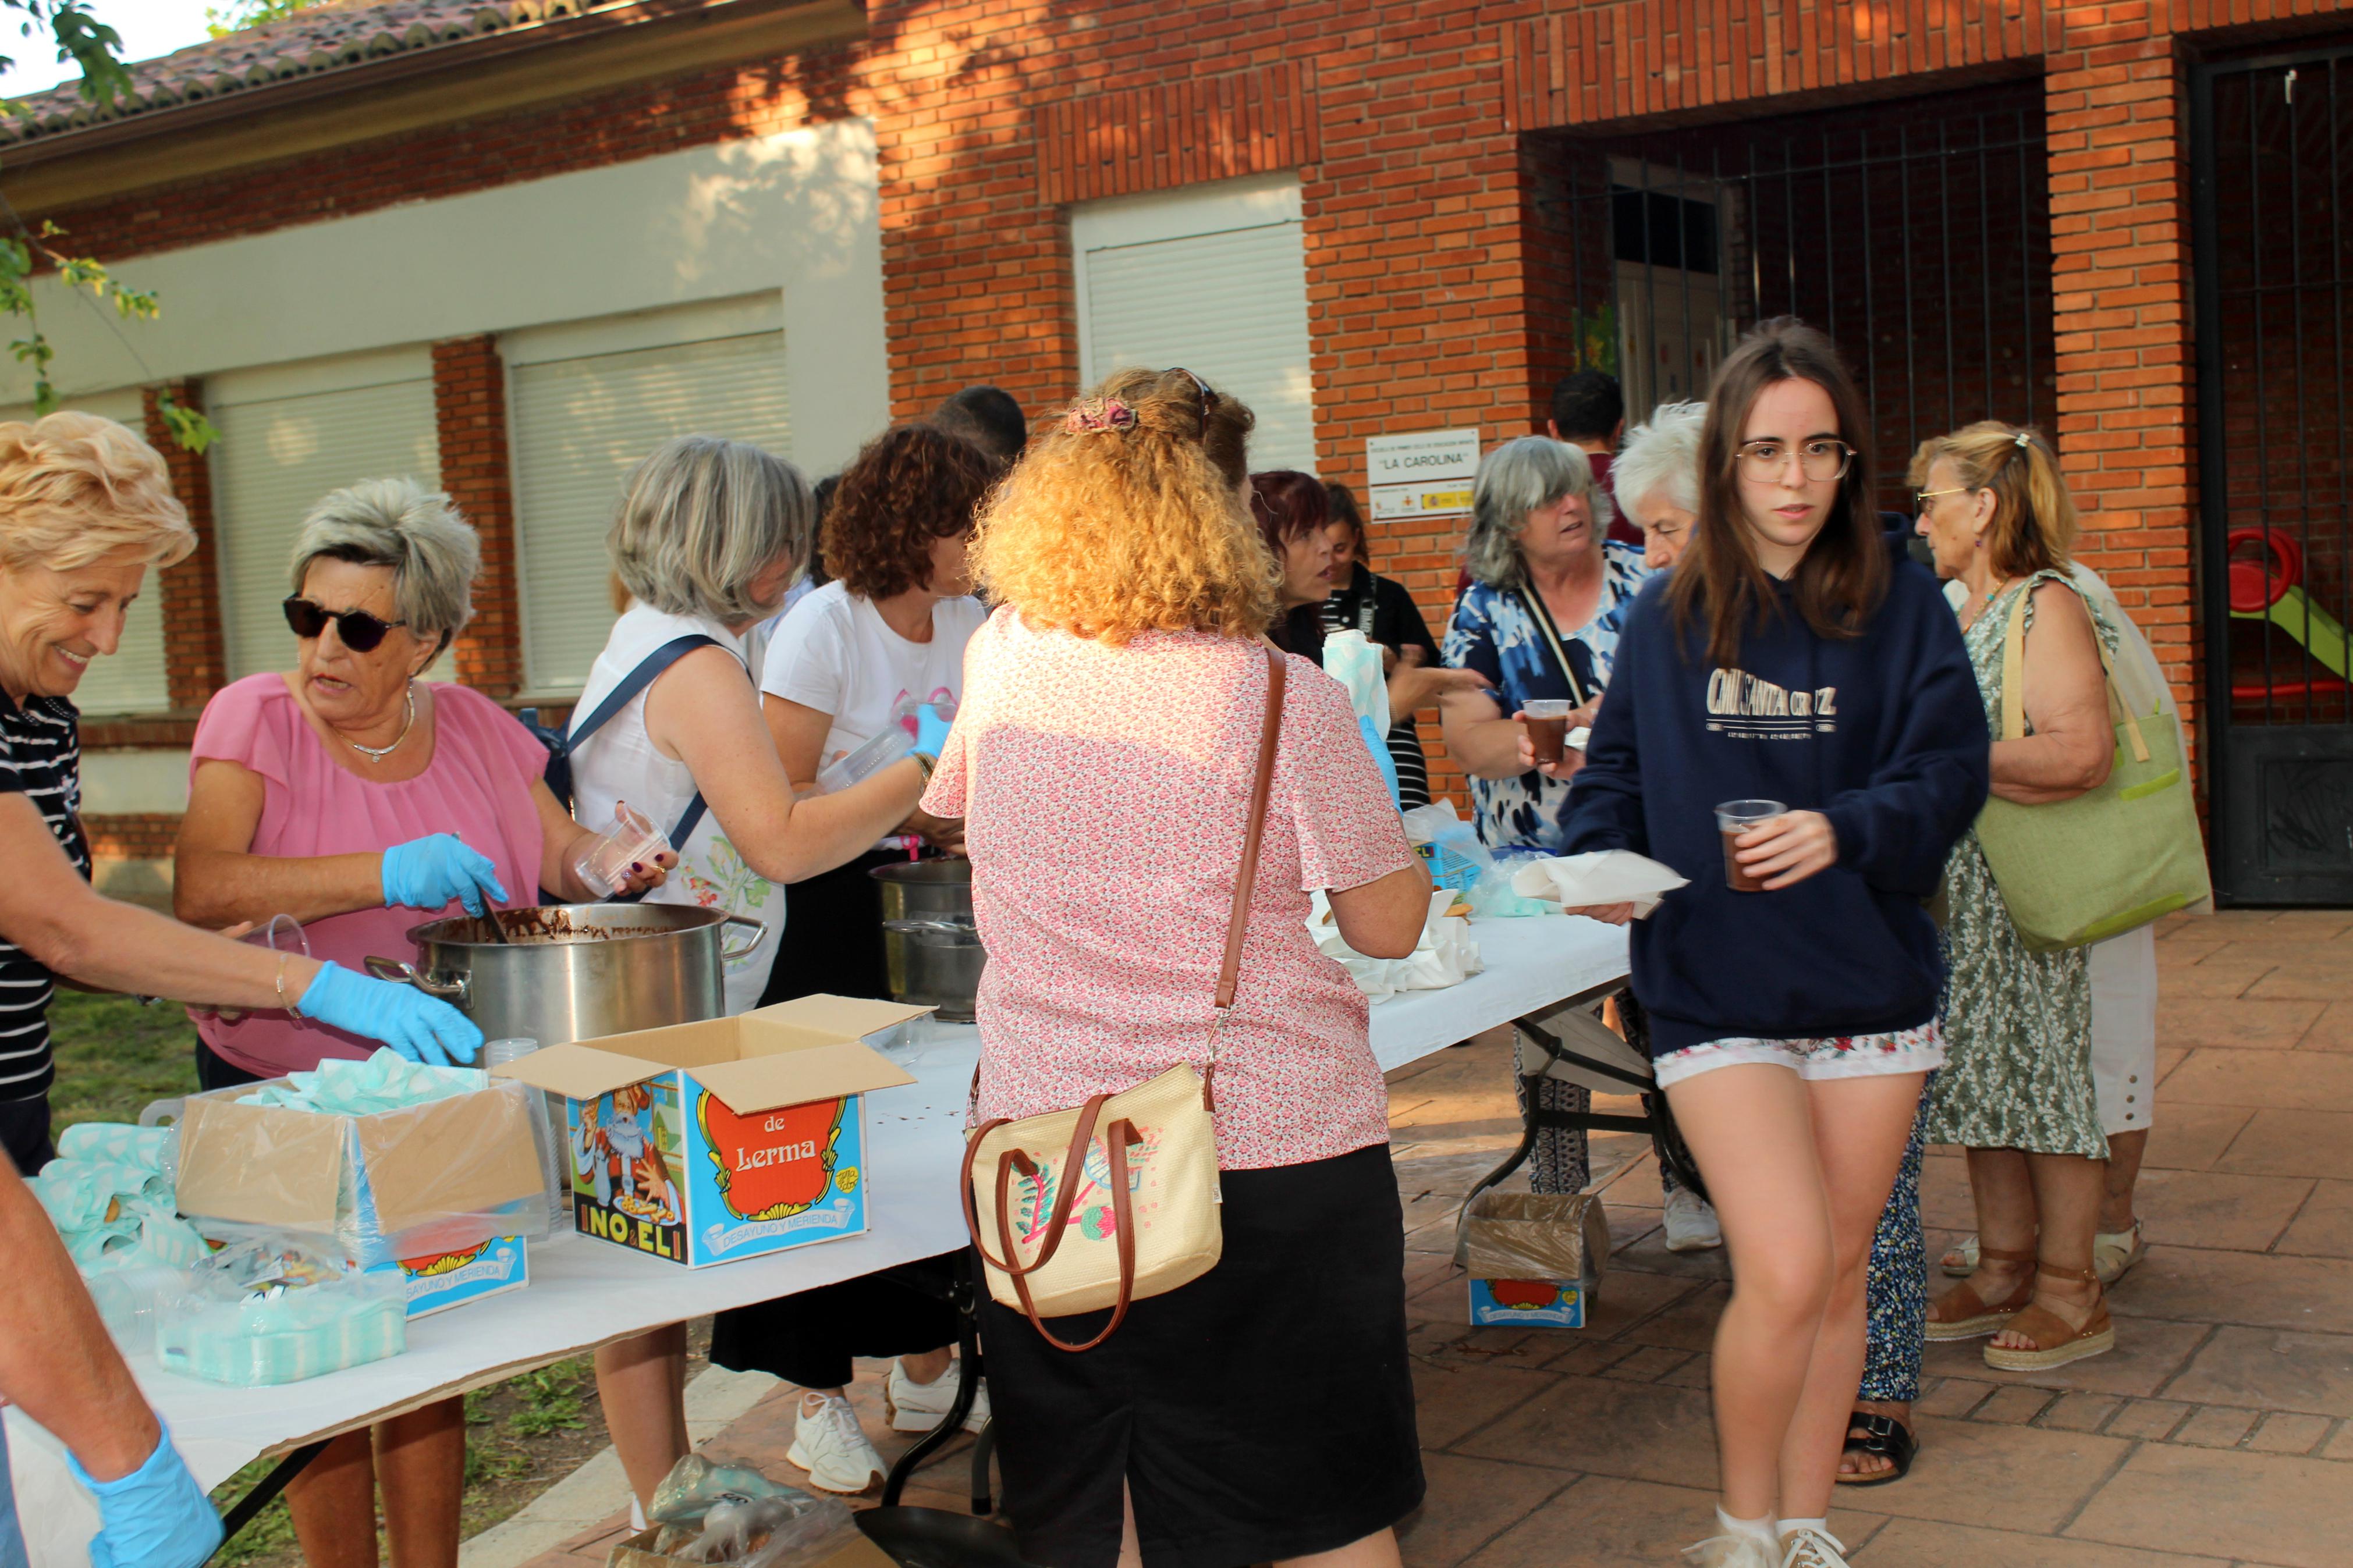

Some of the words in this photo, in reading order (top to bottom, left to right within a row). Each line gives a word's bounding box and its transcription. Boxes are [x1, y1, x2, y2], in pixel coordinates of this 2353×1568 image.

[764, 1116, 785, 1132] de
[736, 1140, 816, 1172] Lerma
[723, 1223, 778, 1248] DESAYUNO
[778, 1222, 786, 1232] Y
[788, 1214, 837, 1229] MERIENDA
[445, 1277, 453, 1285] Y
[455, 1265, 499, 1283] MERIENDA
